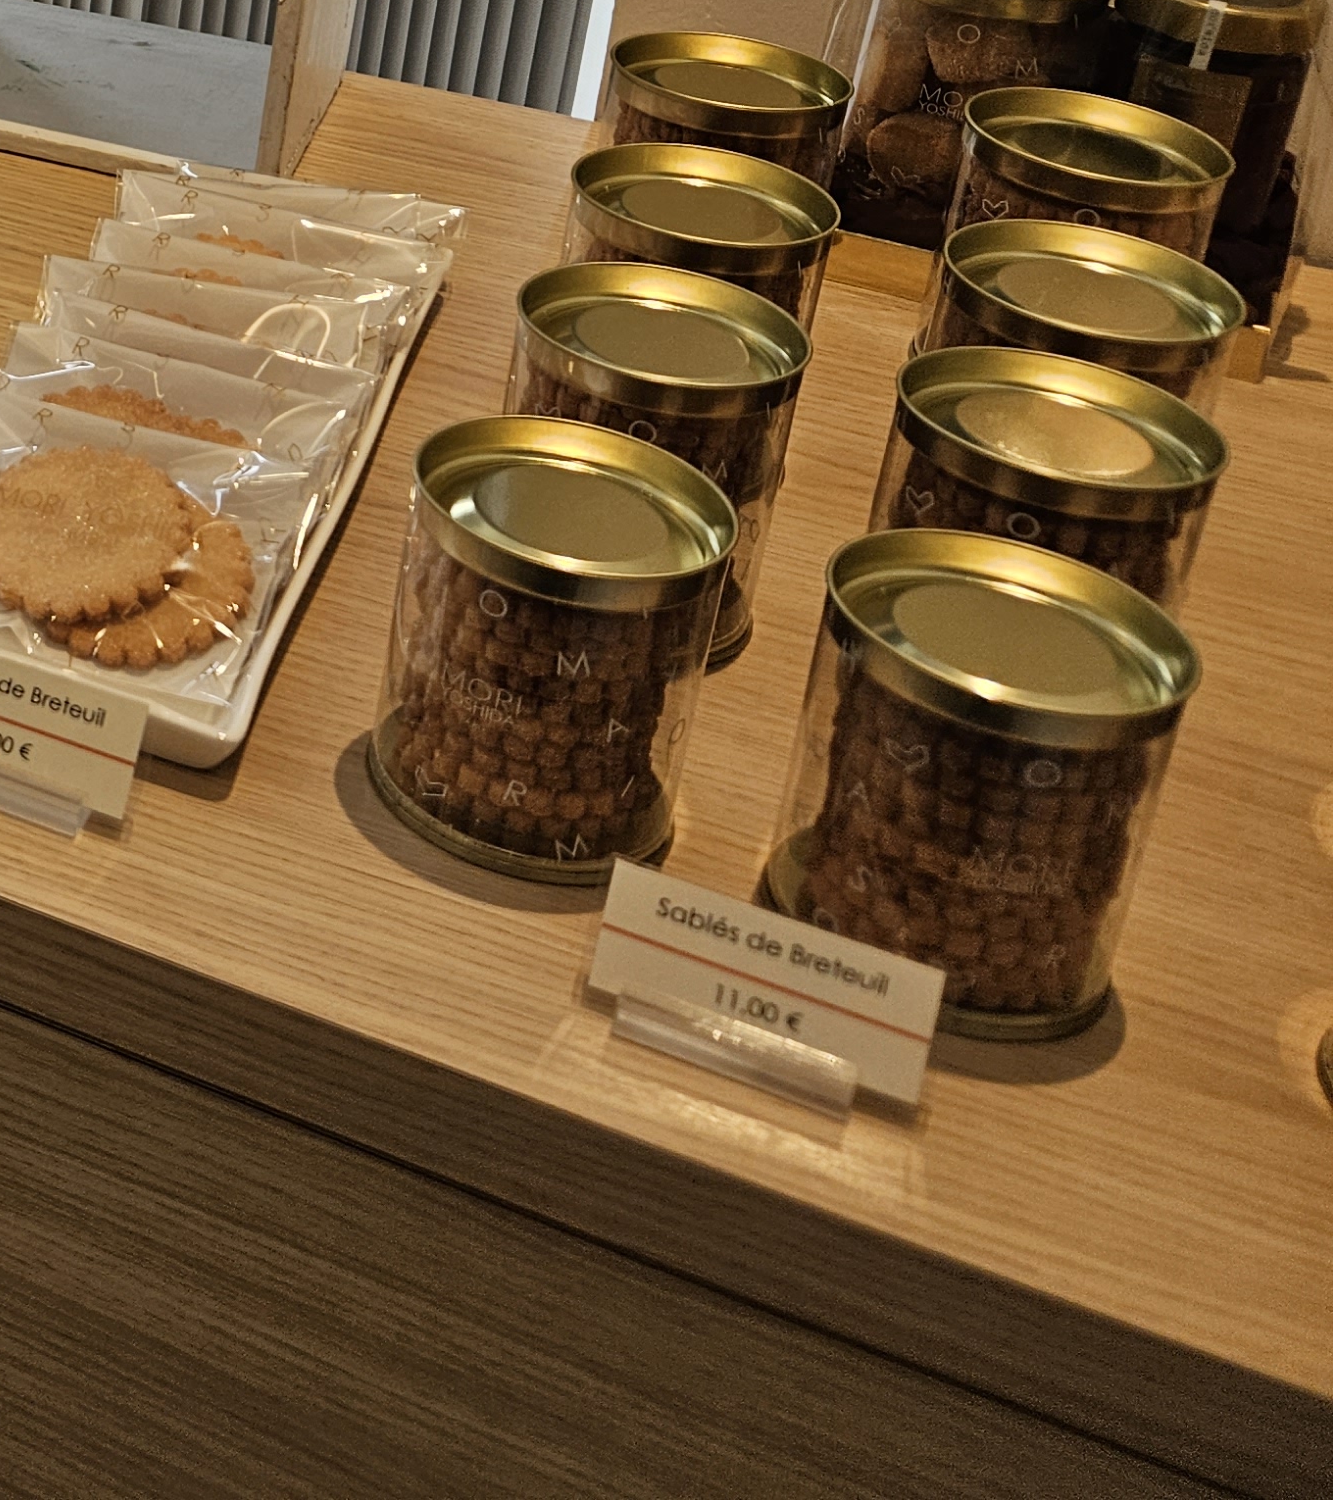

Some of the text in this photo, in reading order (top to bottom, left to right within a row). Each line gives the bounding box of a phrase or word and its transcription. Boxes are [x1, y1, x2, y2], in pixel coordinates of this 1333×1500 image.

[919, 84, 964, 108] MO
[918, 100, 965, 121] YOSHI
[441, 665, 525, 716] MORI
[29, 686, 107, 729] Breteuil
[18, 742, 34, 762] €
[655, 896, 892, 999] Sablés de Breteuil
[785, 1011, 807, 1033] €
